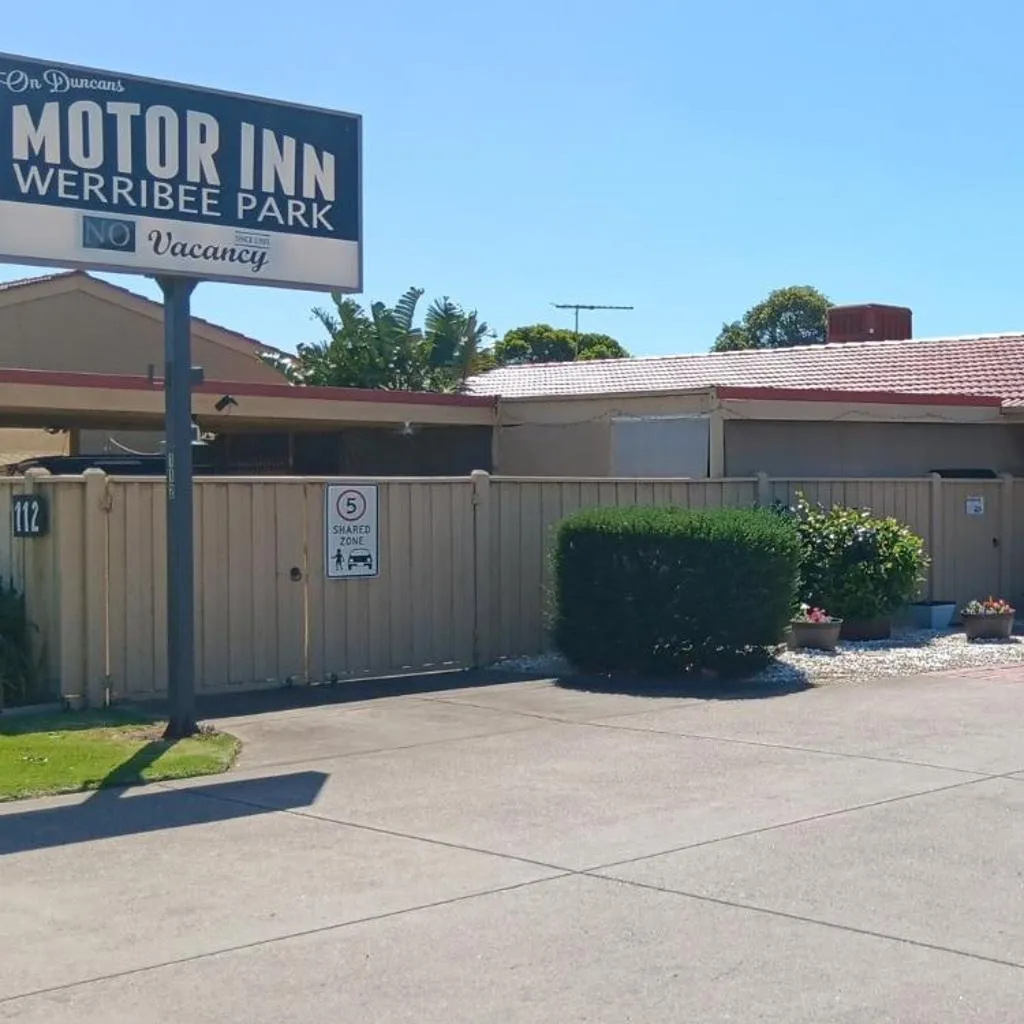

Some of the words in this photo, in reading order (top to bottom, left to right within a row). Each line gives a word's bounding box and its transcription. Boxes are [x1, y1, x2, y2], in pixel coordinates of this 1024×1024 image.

[0, 69, 42, 92] On
[43, 69, 125, 93] Duncans
[12, 100, 220, 185] MOTOR
[240, 121, 336, 202] INN
[12, 163, 222, 217] WERRIBEE
[237, 192, 335, 231] PARK
[84, 219, 131, 248] NO
[148, 229, 269, 273] Vacancy
[14, 500, 39, 532] 112
[346, 498, 357, 514] 5
[332, 524, 371, 535] SHARED
[339, 536, 366, 546] ZONE
